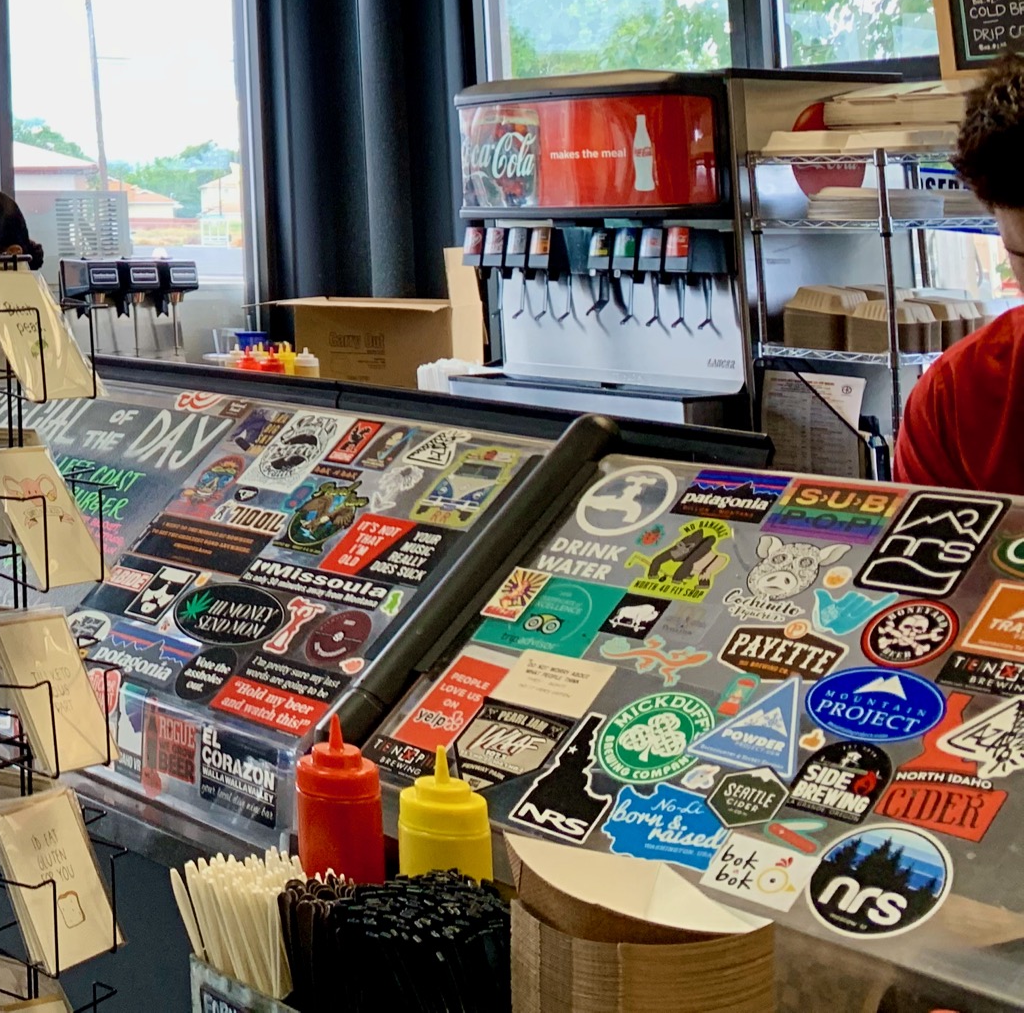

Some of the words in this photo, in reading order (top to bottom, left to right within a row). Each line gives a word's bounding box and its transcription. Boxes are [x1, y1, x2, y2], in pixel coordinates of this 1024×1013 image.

[969, 3, 1006, 20] COLD
[973, 25, 1006, 42] DRIP
[550, 149, 580, 160] makes
[582, 149, 599, 159] the
[601, 148, 626, 159] meal
[109, 409, 139, 425] OF
[83, 429, 126, 450] THE
[124, 408, 235, 471] DAY
[90, 465, 147, 491] COAST
[681, 492, 771, 511] patagonia
[355, 532, 384, 547] THAT
[357, 520, 380, 533] IT'S
[378, 524, 402, 537] NOT
[413, 531, 442, 545] YOUR
[684, 523, 696, 533] NO
[338, 554, 360, 567] OLD
[387, 551, 427, 567] REALLY
[400, 541, 435, 557] MUSIC
[549, 537, 627, 562] DRINK
[369, 560, 398, 574] DOES
[396, 566, 427, 581] SUCK
[536, 554, 612, 581] WATER
[265, 562, 388, 599] Missoula
[634, 580, 659, 592] NORTH
[670, 586, 683, 594] FLY
[683, 587, 705, 599] SHOP
[225, 600, 280, 624] MONEY
[724, 589, 800, 616] Cochinito
[195, 615, 228, 633] SEND
[227, 620, 266, 639] MOM
[196, 656, 216, 670] Vote
[215, 662, 232, 674] the
[727, 633, 837, 674] PAYETTE
[184, 667, 224, 685] assholes
[245, 667, 270, 682] words
[269, 675, 284, 686] are
[282, 678, 307, 694] going
[306, 685, 318, 695] to
[317, 687, 330, 699] be
[264, 660, 290, 677] pretty
[289, 668, 311, 679] sure
[310, 673, 324, 687] my
[323, 675, 341, 689] last
[449, 671, 490, 691] PEOPLE
[268, 691, 287, 708] my
[285, 696, 315, 715] beer
[439, 683, 466, 699] LOVE
[465, 689, 483, 703] US
[443, 698, 460, 709] ON
[825, 689, 927, 718] MOUNTAIN
[220, 696, 244, 711] and
[243, 702, 277, 721] watch
[413, 708, 448, 730] yelp
[815, 698, 921, 734] PROJECT
[158, 716, 197, 749] ROGUE
[497, 709, 527, 726] PEARL
[525, 717, 550, 733] JAM
[202, 724, 222, 749] EL
[721, 728, 786, 753] POWDER
[157, 752, 196, 782] BEER
[379, 756, 422, 776] BREWING
[603, 735, 632, 777] BREWING
[201, 746, 276, 792] CORAZON
[803, 764, 855, 792] SIDE
[895, 771, 947, 783] NORTH
[948, 773, 992, 790] IDAHO
[724, 782, 776, 809] SEATTLE
[726, 797, 759, 813] CIDER
[791, 780, 871, 814] BREWING
[517, 802, 589, 836] NRS
[611, 798, 666, 827] born
[882, 787, 985, 830] CIDER
[648, 827, 724, 851] raised
[721, 844, 759, 871] bok
[715, 868, 758, 891] bok
[817, 875, 909, 927] nrs
